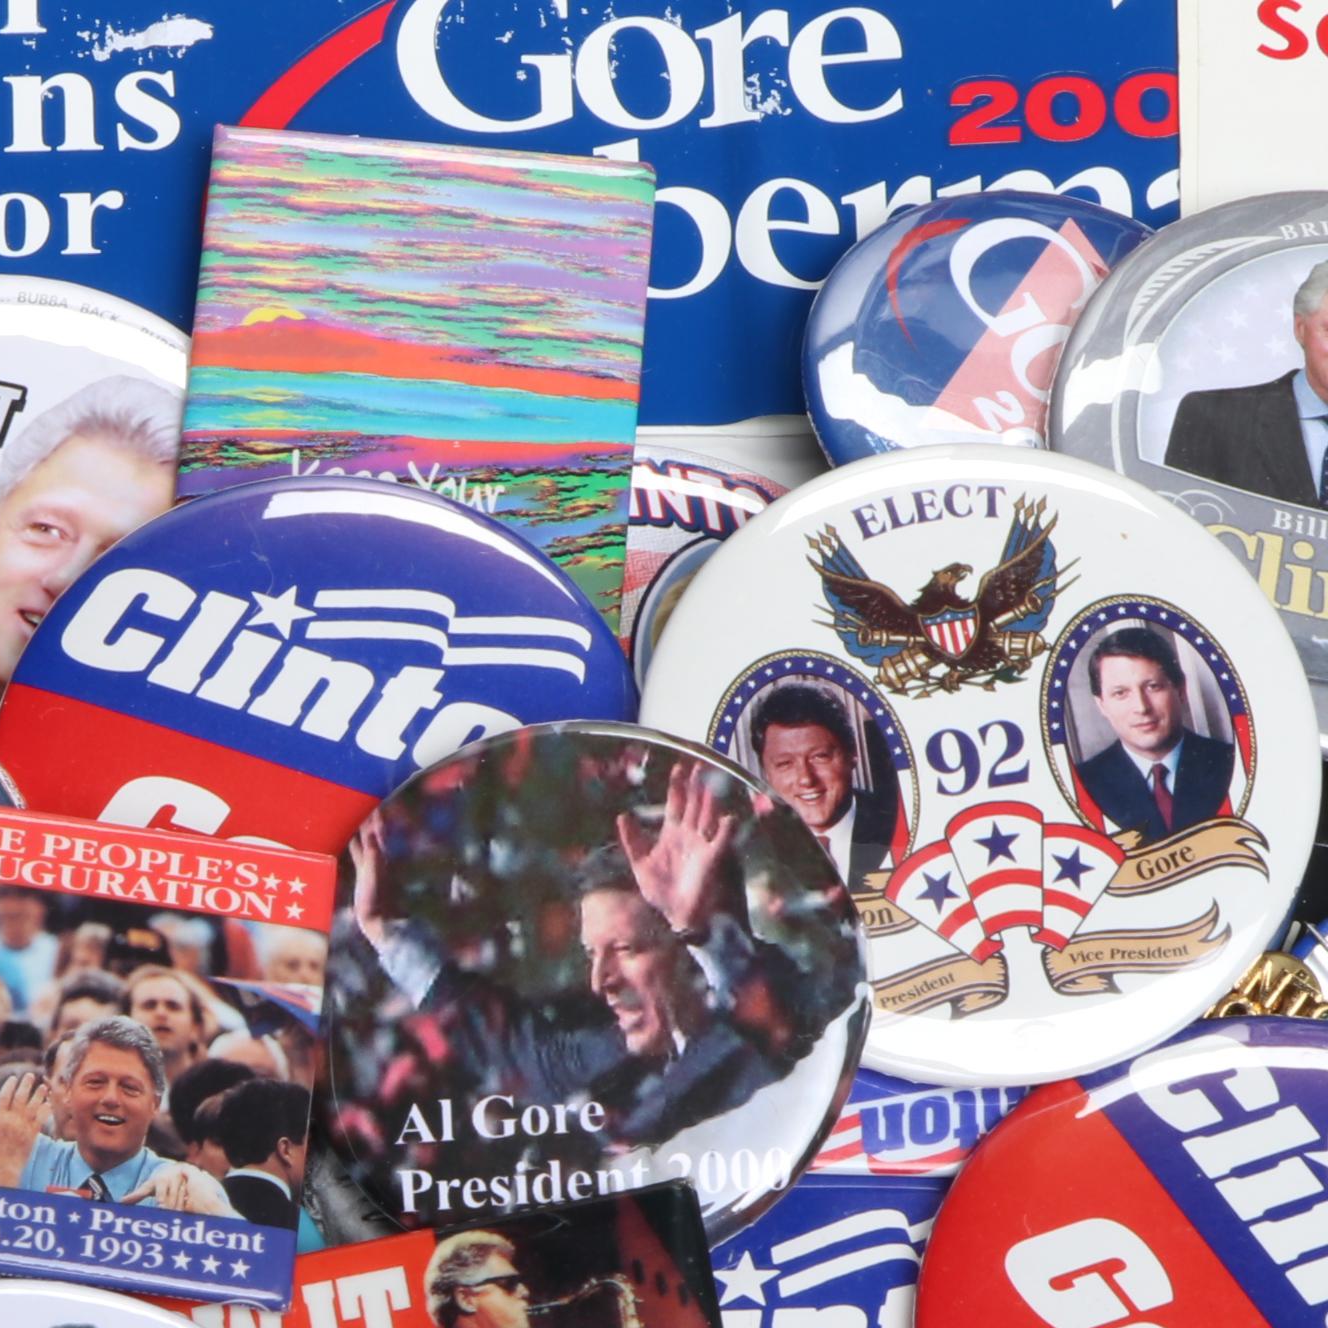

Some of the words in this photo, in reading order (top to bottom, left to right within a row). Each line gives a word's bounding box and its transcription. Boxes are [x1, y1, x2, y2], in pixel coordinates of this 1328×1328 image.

[396, 0, 903, 133] Gore
[16, 290, 69, 308] BUBBA
[851, 484, 1007, 541] ELECT
[925, 719, 1030, 796] 92
[42, 833, 259, 888] PEOPLE'S
[1135, 842, 1195, 881] Gore
[1069, 944, 1105, 968] Vice
[1110, 943, 1190, 963] President
[878, 971, 956, 1009] President
[395, 1099, 454, 1145] Al
[471, 1093, 606, 1140] Gore
[396, 1154, 650, 1214] President
[80, 1234, 164, 1270] 1993
[90, 1208, 265, 1255] President
